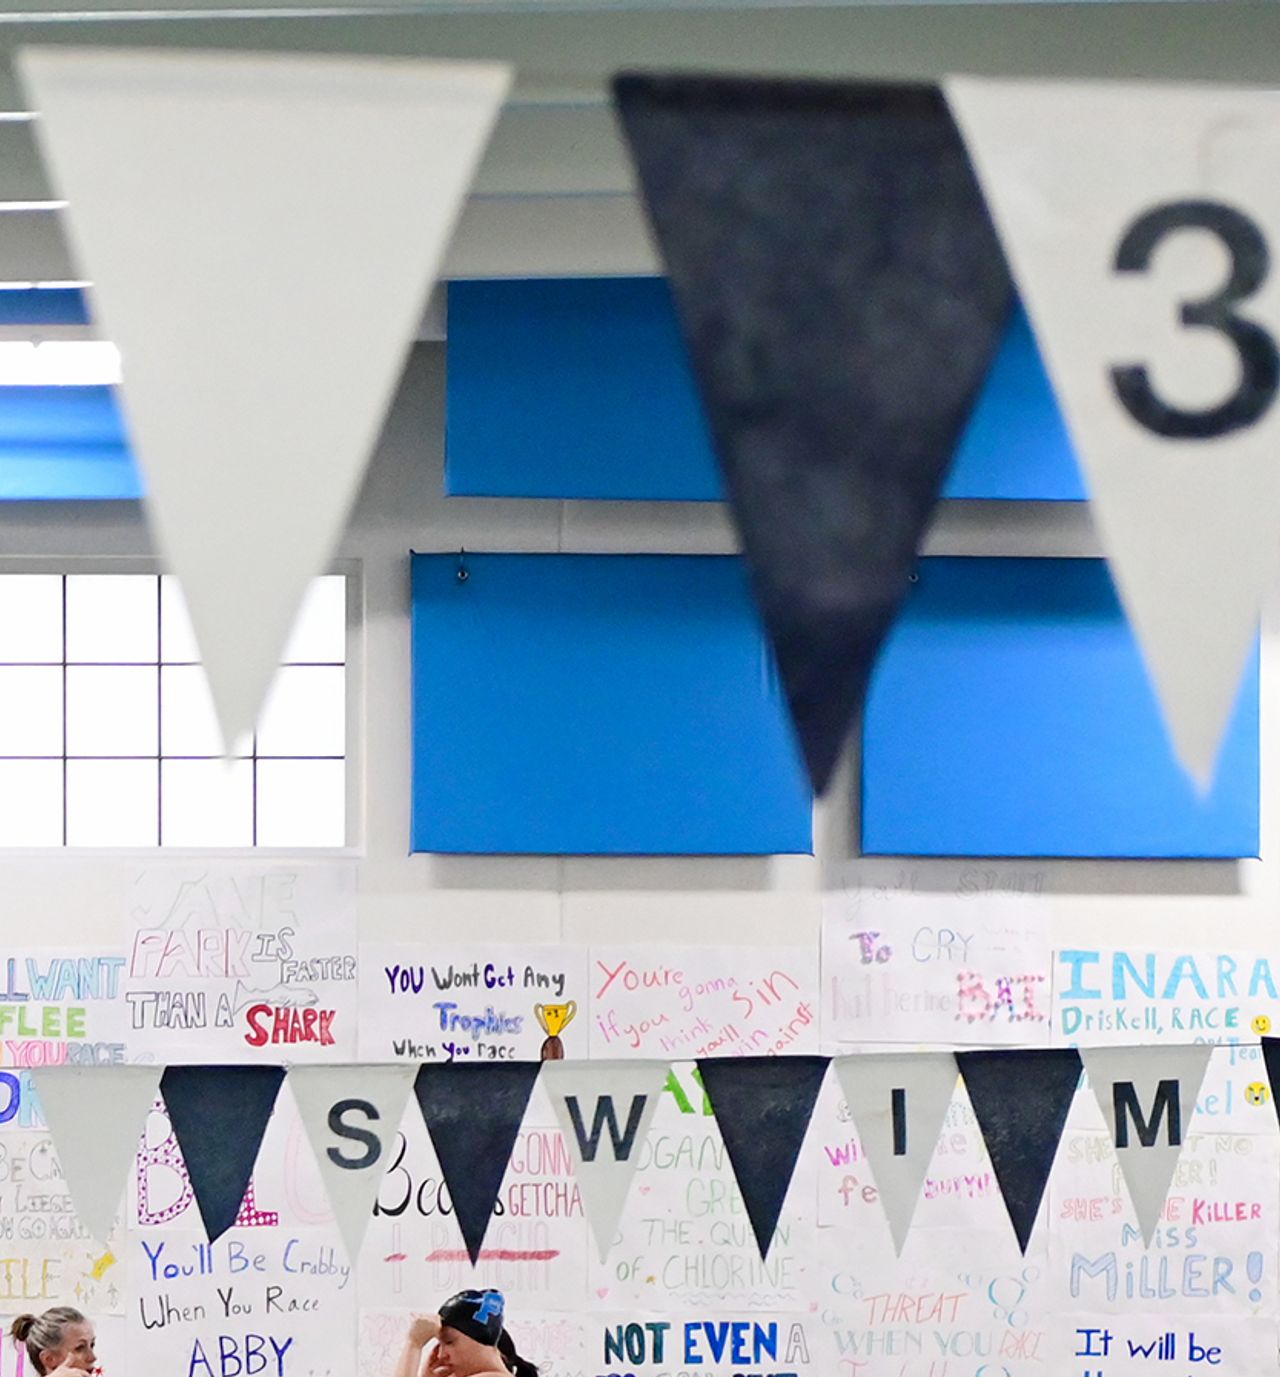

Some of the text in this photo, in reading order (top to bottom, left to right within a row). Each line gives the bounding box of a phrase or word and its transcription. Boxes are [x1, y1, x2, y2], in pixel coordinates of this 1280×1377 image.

[1108, 199, 1280, 440] 3
[130, 926, 296, 979] PARK IS
[912, 926, 974, 962] CRY
[25, 956, 127, 1001] WANT
[280, 955, 357, 985] FASTER
[385, 965, 424, 995] YOU
[484, 963, 515, 989] Get
[523, 965, 566, 997] Any
[596, 959, 738, 1012] You're gonna
[1059, 949, 1279, 1001] INARA
[125, 990, 336, 1048] THAN A SHARK
[596, 1009, 622, 1043] if
[1171, 1006, 1240, 1031] RACE
[5, 1039, 69, 1067] YOU
[325, 1078, 1183, 1170] SWIM
[508, 1181, 585, 1218] GETCHA
[641, 1218, 694, 1246] THE
[141, 1238, 351, 1289] You'll Be Crabby
[662, 1253, 795, 1291] CHLORINE
[139, 1285, 320, 1330] When You Race
[862, 1291, 969, 1326] THREAT
[604, 1321, 671, 1366] NOT
[683, 1321, 778, 1365] EVEN
[784, 1322, 810, 1364] A
[833, 1330, 923, 1356] WHEN
[933, 1329, 992, 1357] YOU
[1075, 1328, 1222, 1365] It will be
